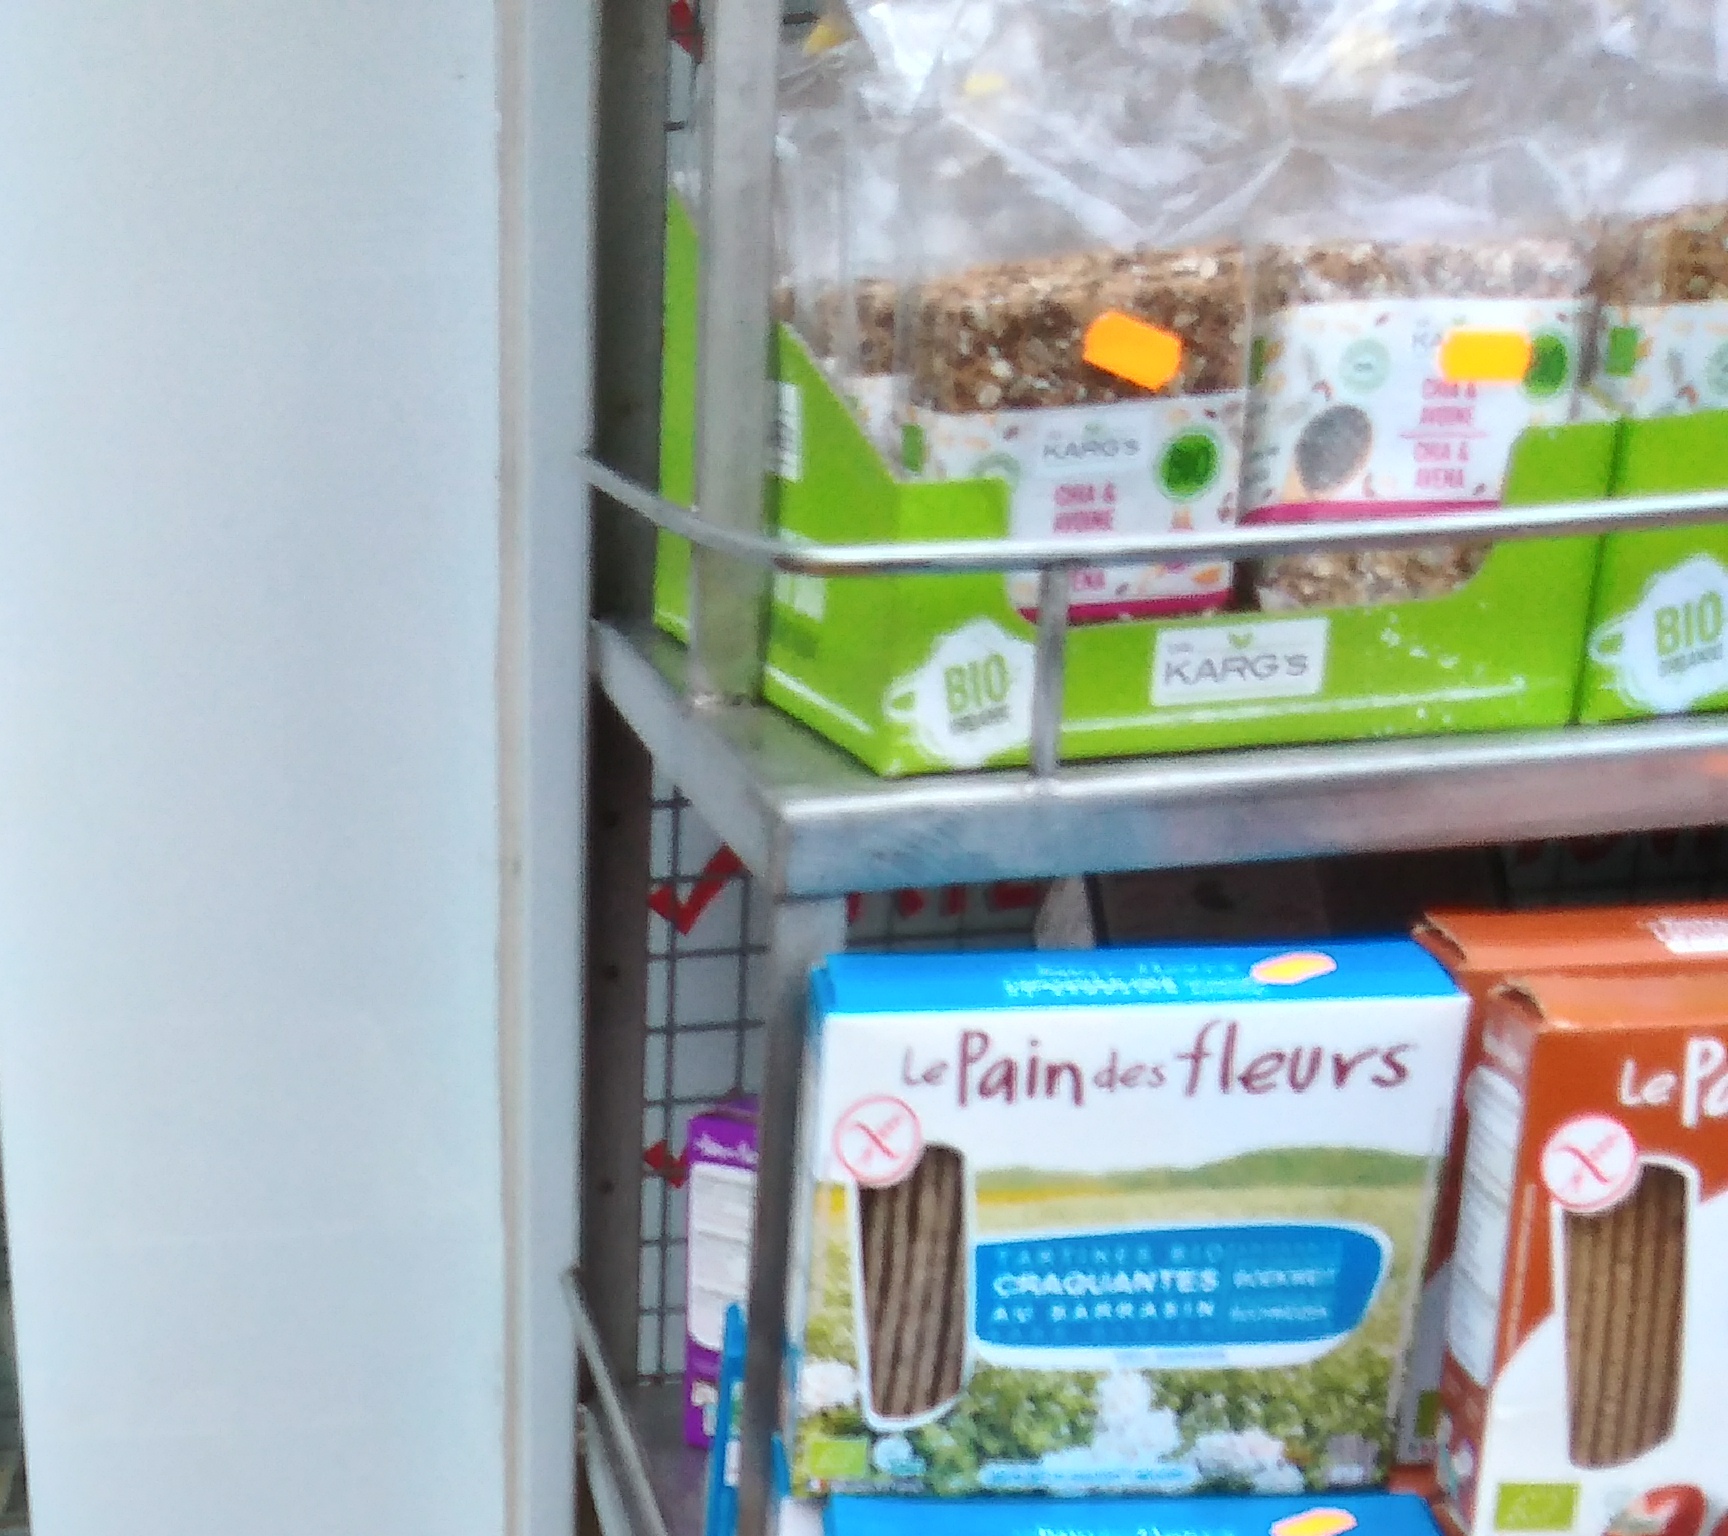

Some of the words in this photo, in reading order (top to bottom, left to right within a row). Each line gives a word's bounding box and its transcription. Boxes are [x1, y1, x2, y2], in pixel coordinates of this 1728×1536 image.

[1656, 591, 1723, 657] BIO
[944, 653, 1011, 713] BIO
[900, 1047, 948, 1085] Le
[956, 1028, 1085, 1108] Pain
[1093, 1049, 1168, 1092] des
[1176, 1019, 1418, 1097] fleurs
[1617, 1057, 1678, 1106] Le
